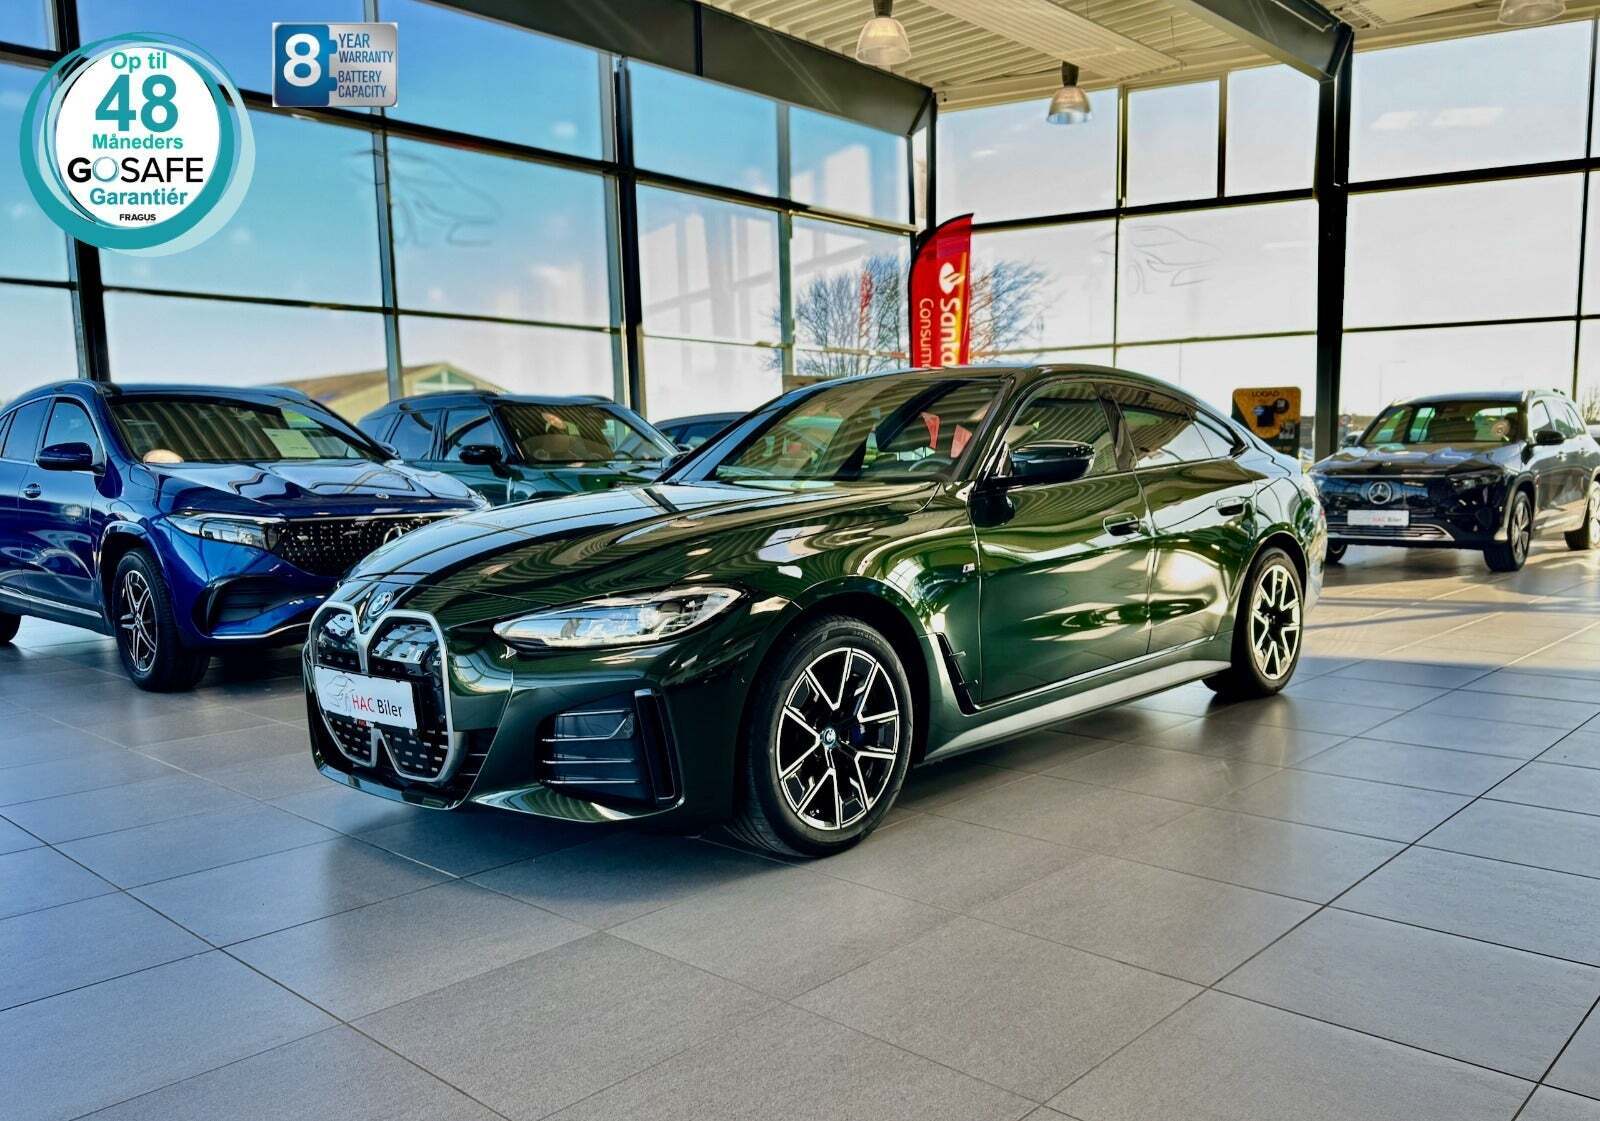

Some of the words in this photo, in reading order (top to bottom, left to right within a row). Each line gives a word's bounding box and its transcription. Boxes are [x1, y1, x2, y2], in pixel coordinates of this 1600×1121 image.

[940, 297, 961, 366] Santa
[352, 695, 374, 712] HAC
[377, 699, 402, 717] Biler
